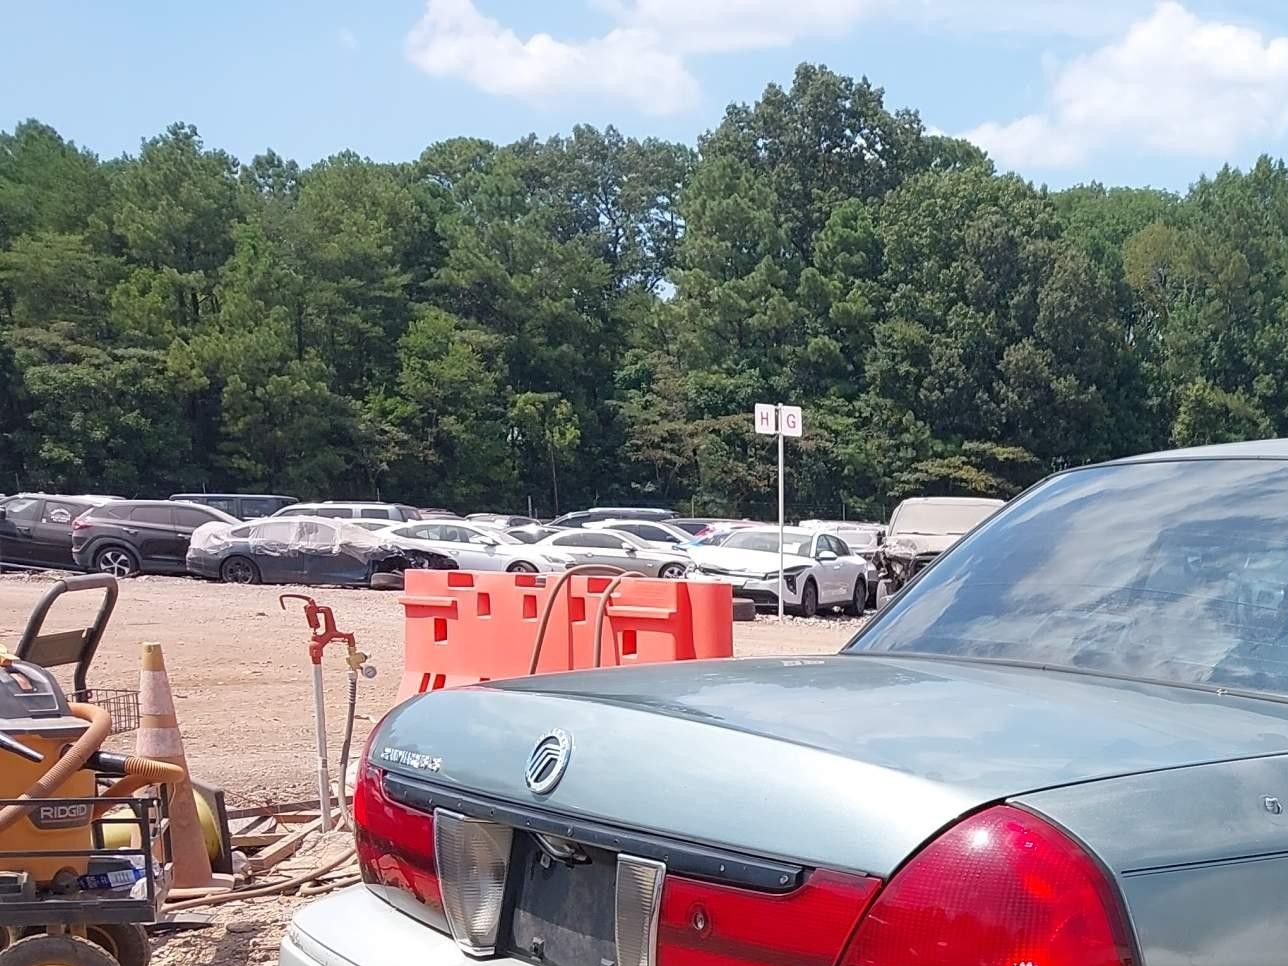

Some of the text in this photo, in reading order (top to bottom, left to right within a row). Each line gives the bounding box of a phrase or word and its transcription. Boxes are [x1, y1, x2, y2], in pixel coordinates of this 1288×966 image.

[760, 411, 769, 427] H
[786, 413, 796, 429] G
[40, 803, 87, 819] RIDGID
